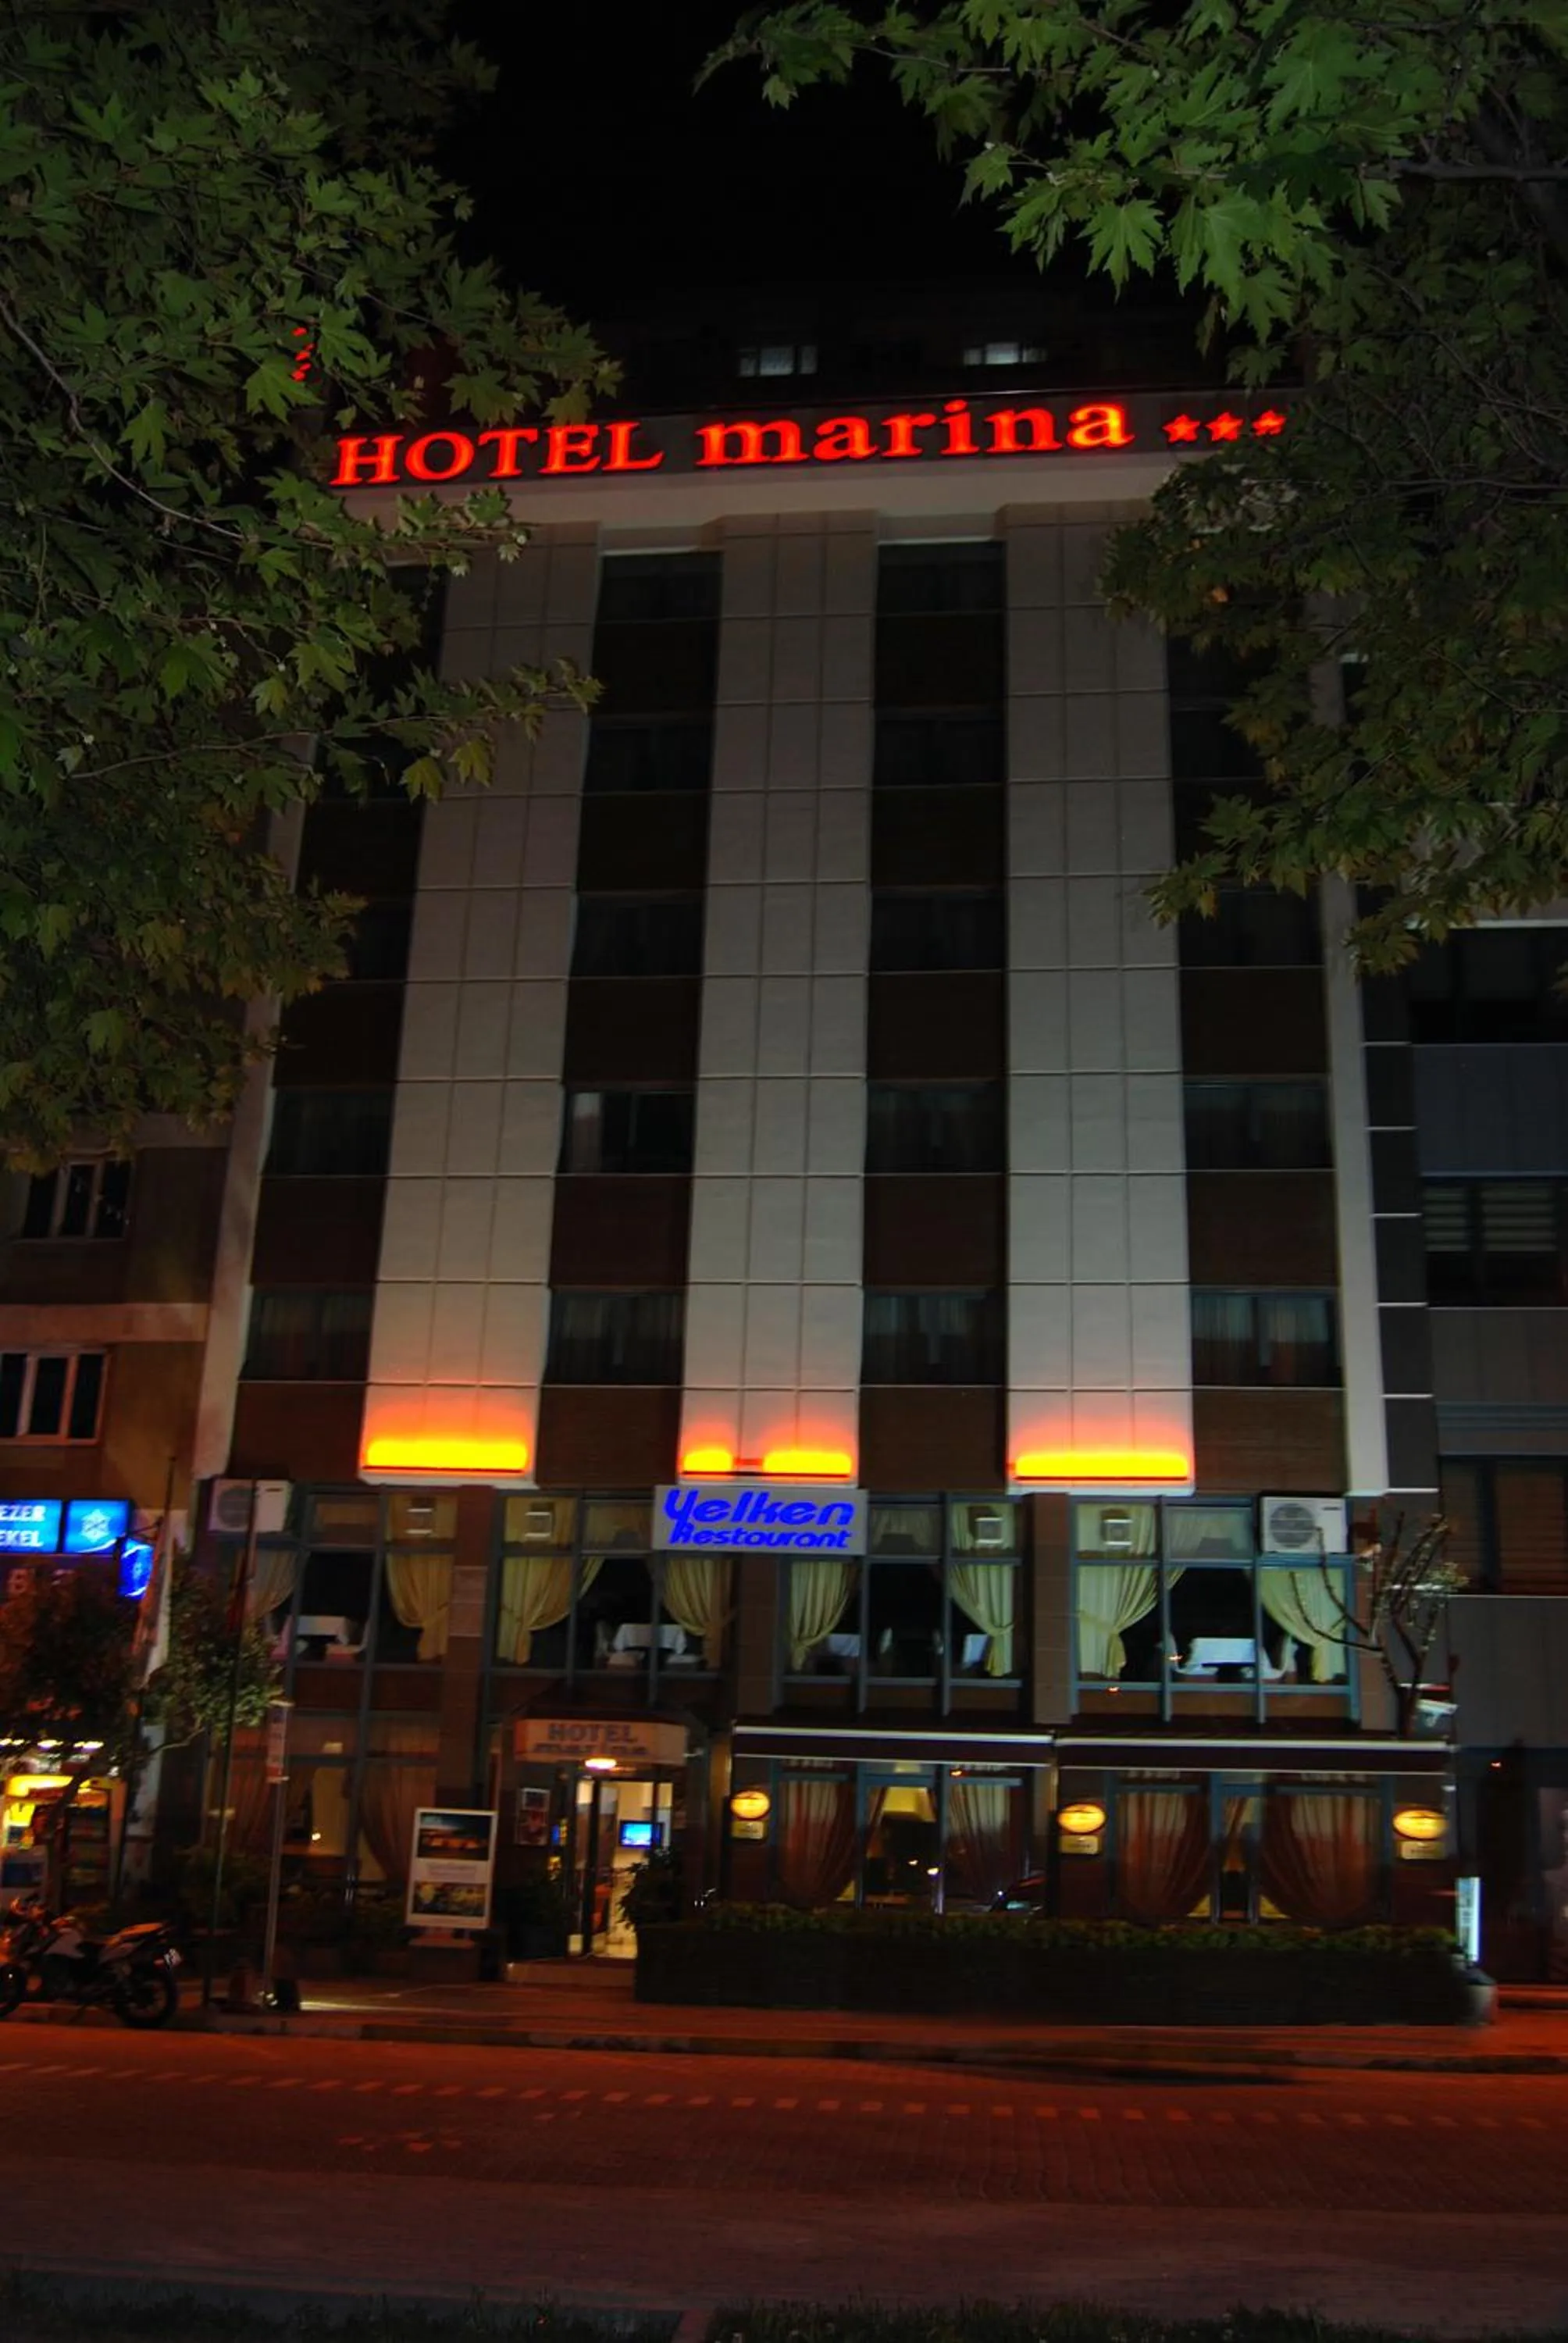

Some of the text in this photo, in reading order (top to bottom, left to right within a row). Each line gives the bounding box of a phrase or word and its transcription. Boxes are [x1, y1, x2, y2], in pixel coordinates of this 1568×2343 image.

[329, 398, 1135, 488] HOTEL marina
[665, 1489, 854, 1526] Yelken
[669, 1522, 853, 1549] Restaurant
[548, 1723, 637, 1744] HOTEL
